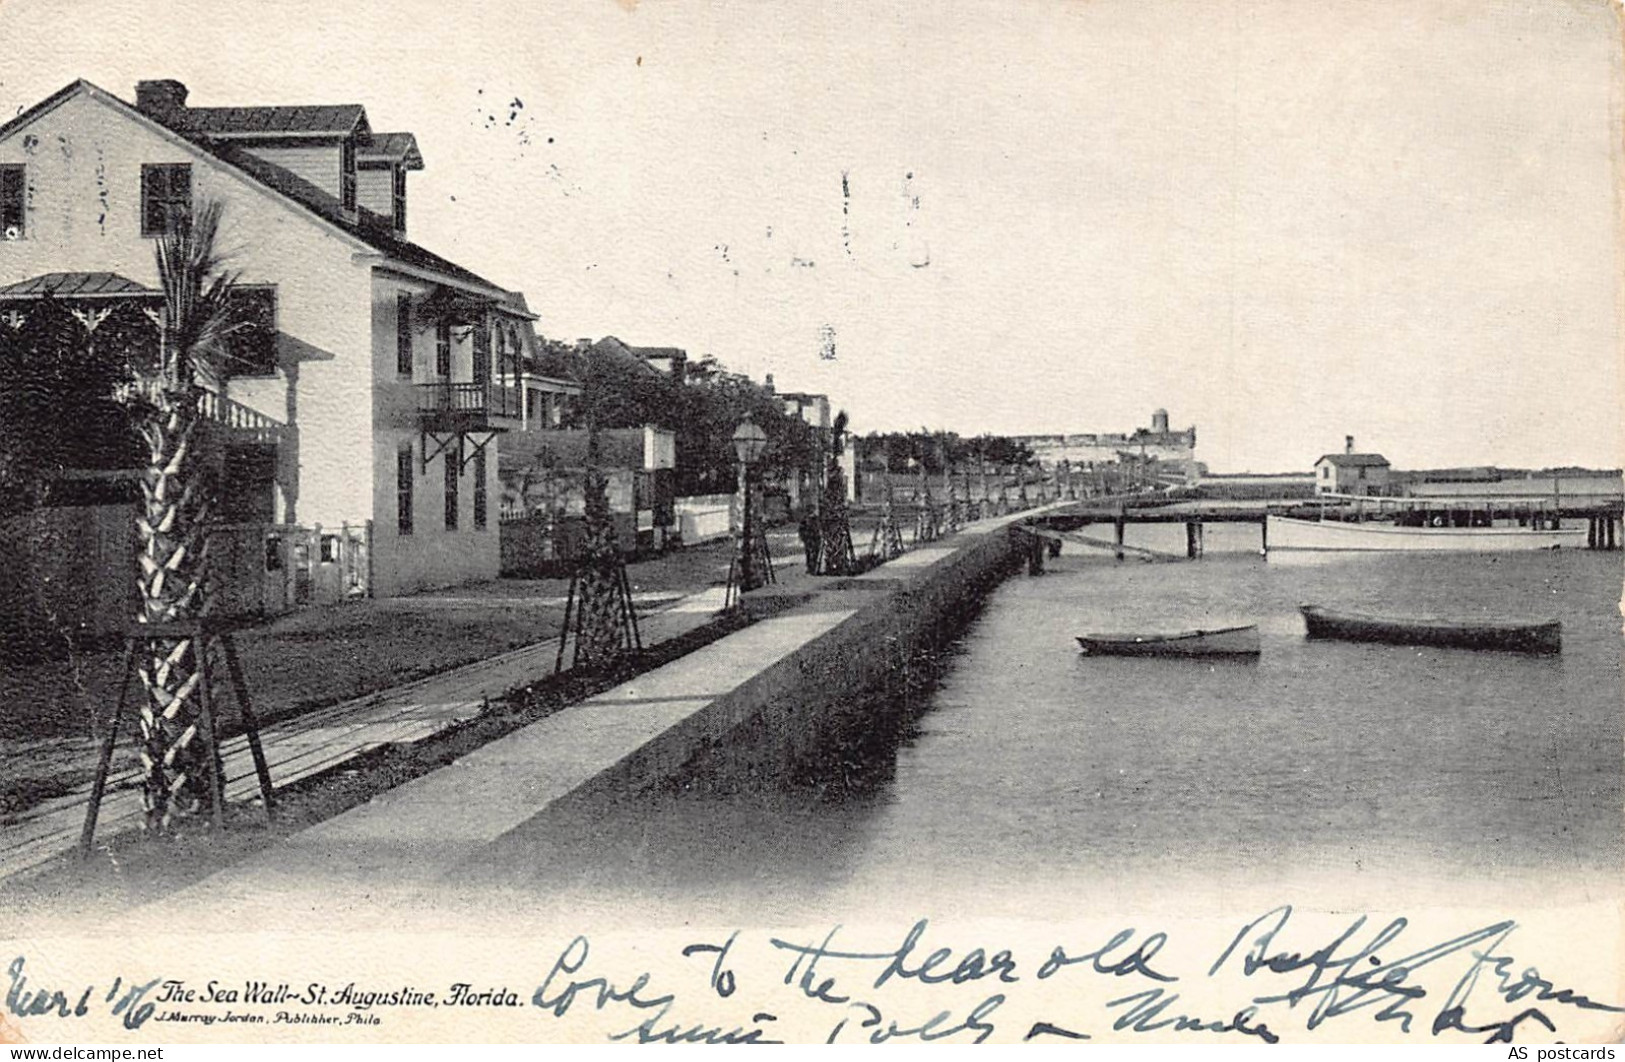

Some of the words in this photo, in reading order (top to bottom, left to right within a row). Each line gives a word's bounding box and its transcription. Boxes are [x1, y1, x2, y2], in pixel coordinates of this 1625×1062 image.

[156, 980, 196, 1003] The
[199, 980, 239, 1004] Sea
[330, 982, 440, 1010] Augustine,
[442, 982, 525, 1008] Florida.
[532, 935, 675, 1018] Love
[769, 924, 878, 1003] the
[1037, 927, 1179, 981] old
